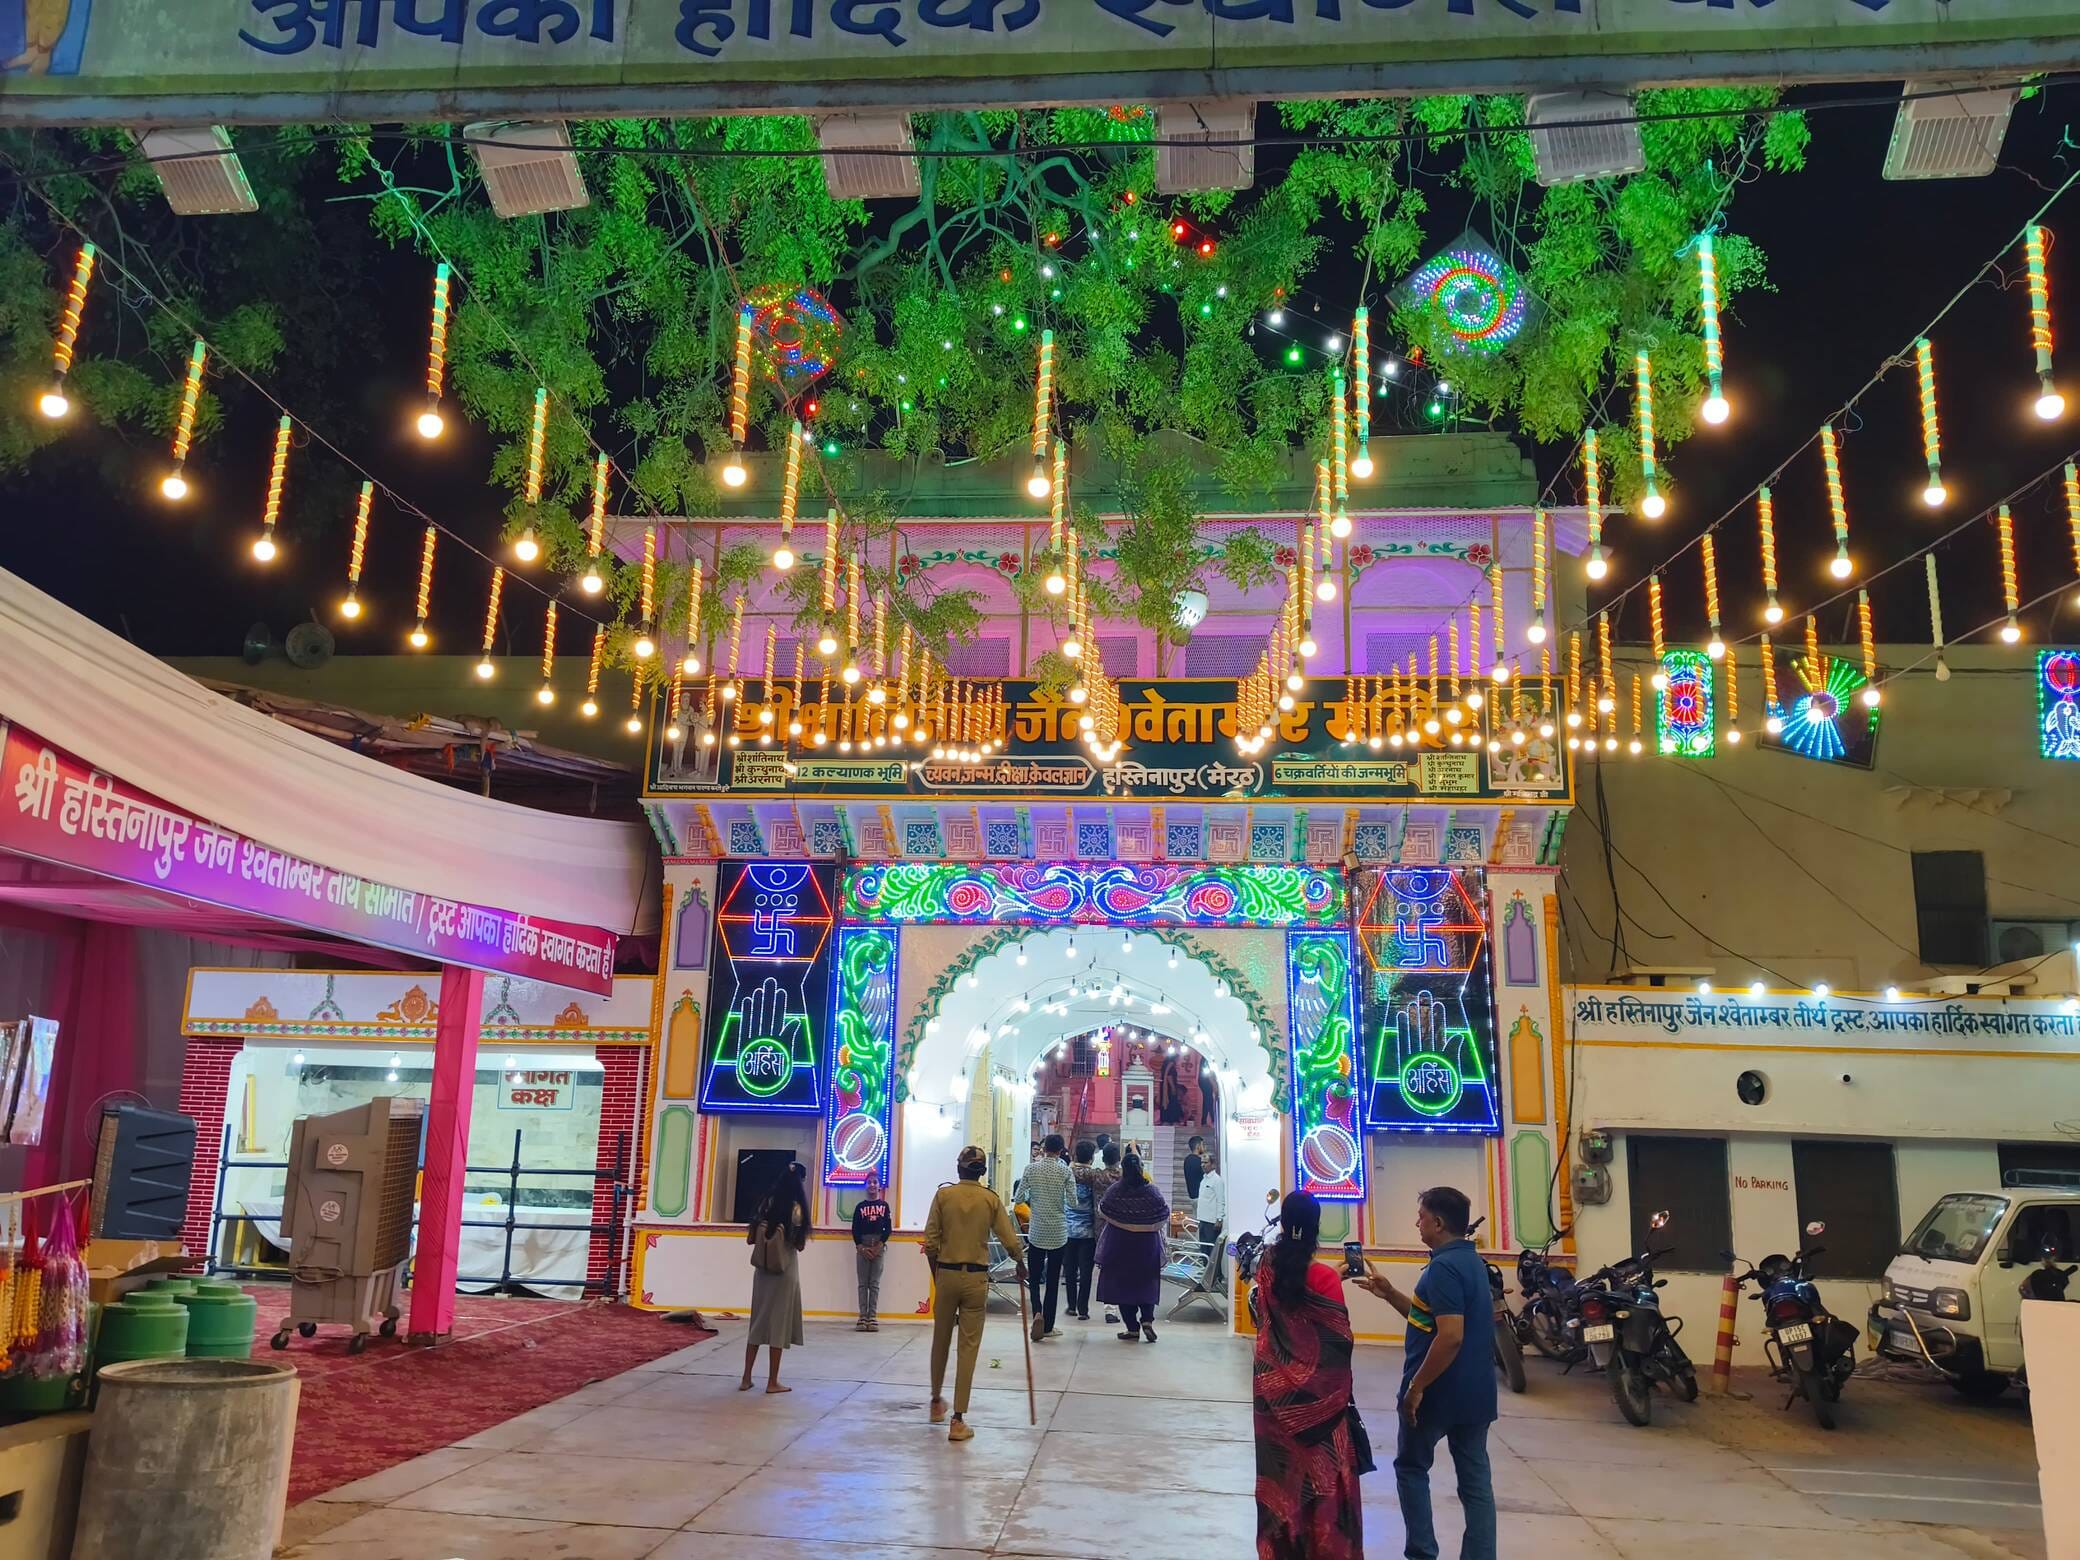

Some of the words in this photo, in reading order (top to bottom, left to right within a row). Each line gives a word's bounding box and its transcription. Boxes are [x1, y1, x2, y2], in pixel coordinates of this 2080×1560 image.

[812, 767, 875, 778] कल्याणक
[877, 762, 903, 782] भूमि
[1275, 768, 1281, 779] 6
[1341, 765, 1357, 779] की
[1357, 764, 1406, 782] जन्मभूमि
[15, 748, 58, 821] श्री
[60, 772, 192, 880] हस्तिनापुर
[457, 905, 502, 947] आपका
[540, 929, 575, 967] स्वागत
[575, 940, 603, 975] करता
[1577, 996, 1602, 1023] श्री
[1605, 995, 1684, 1033] हस्तिनापुर
[1685, 997, 1717, 1026] जैन
[1718, 998, 1792, 1027] श्वेताम्बर
[1794, 1001, 1829, 1028] तीर्थ
[1868, 1010, 1930, 1031] आपका
[1930, 1004, 1979, 1036] हार्दिक
[1978, 1012, 2031, 1034] स्वागत
[2032, 1014, 2075, 1035] करता
[744, 1046, 785, 1077] अहिंसा
[1407, 1062, 1454, 1095] अहिंसा
[511, 1088, 559, 1108] कक्ष
[860, 1205, 886, 1218] MIAMI
